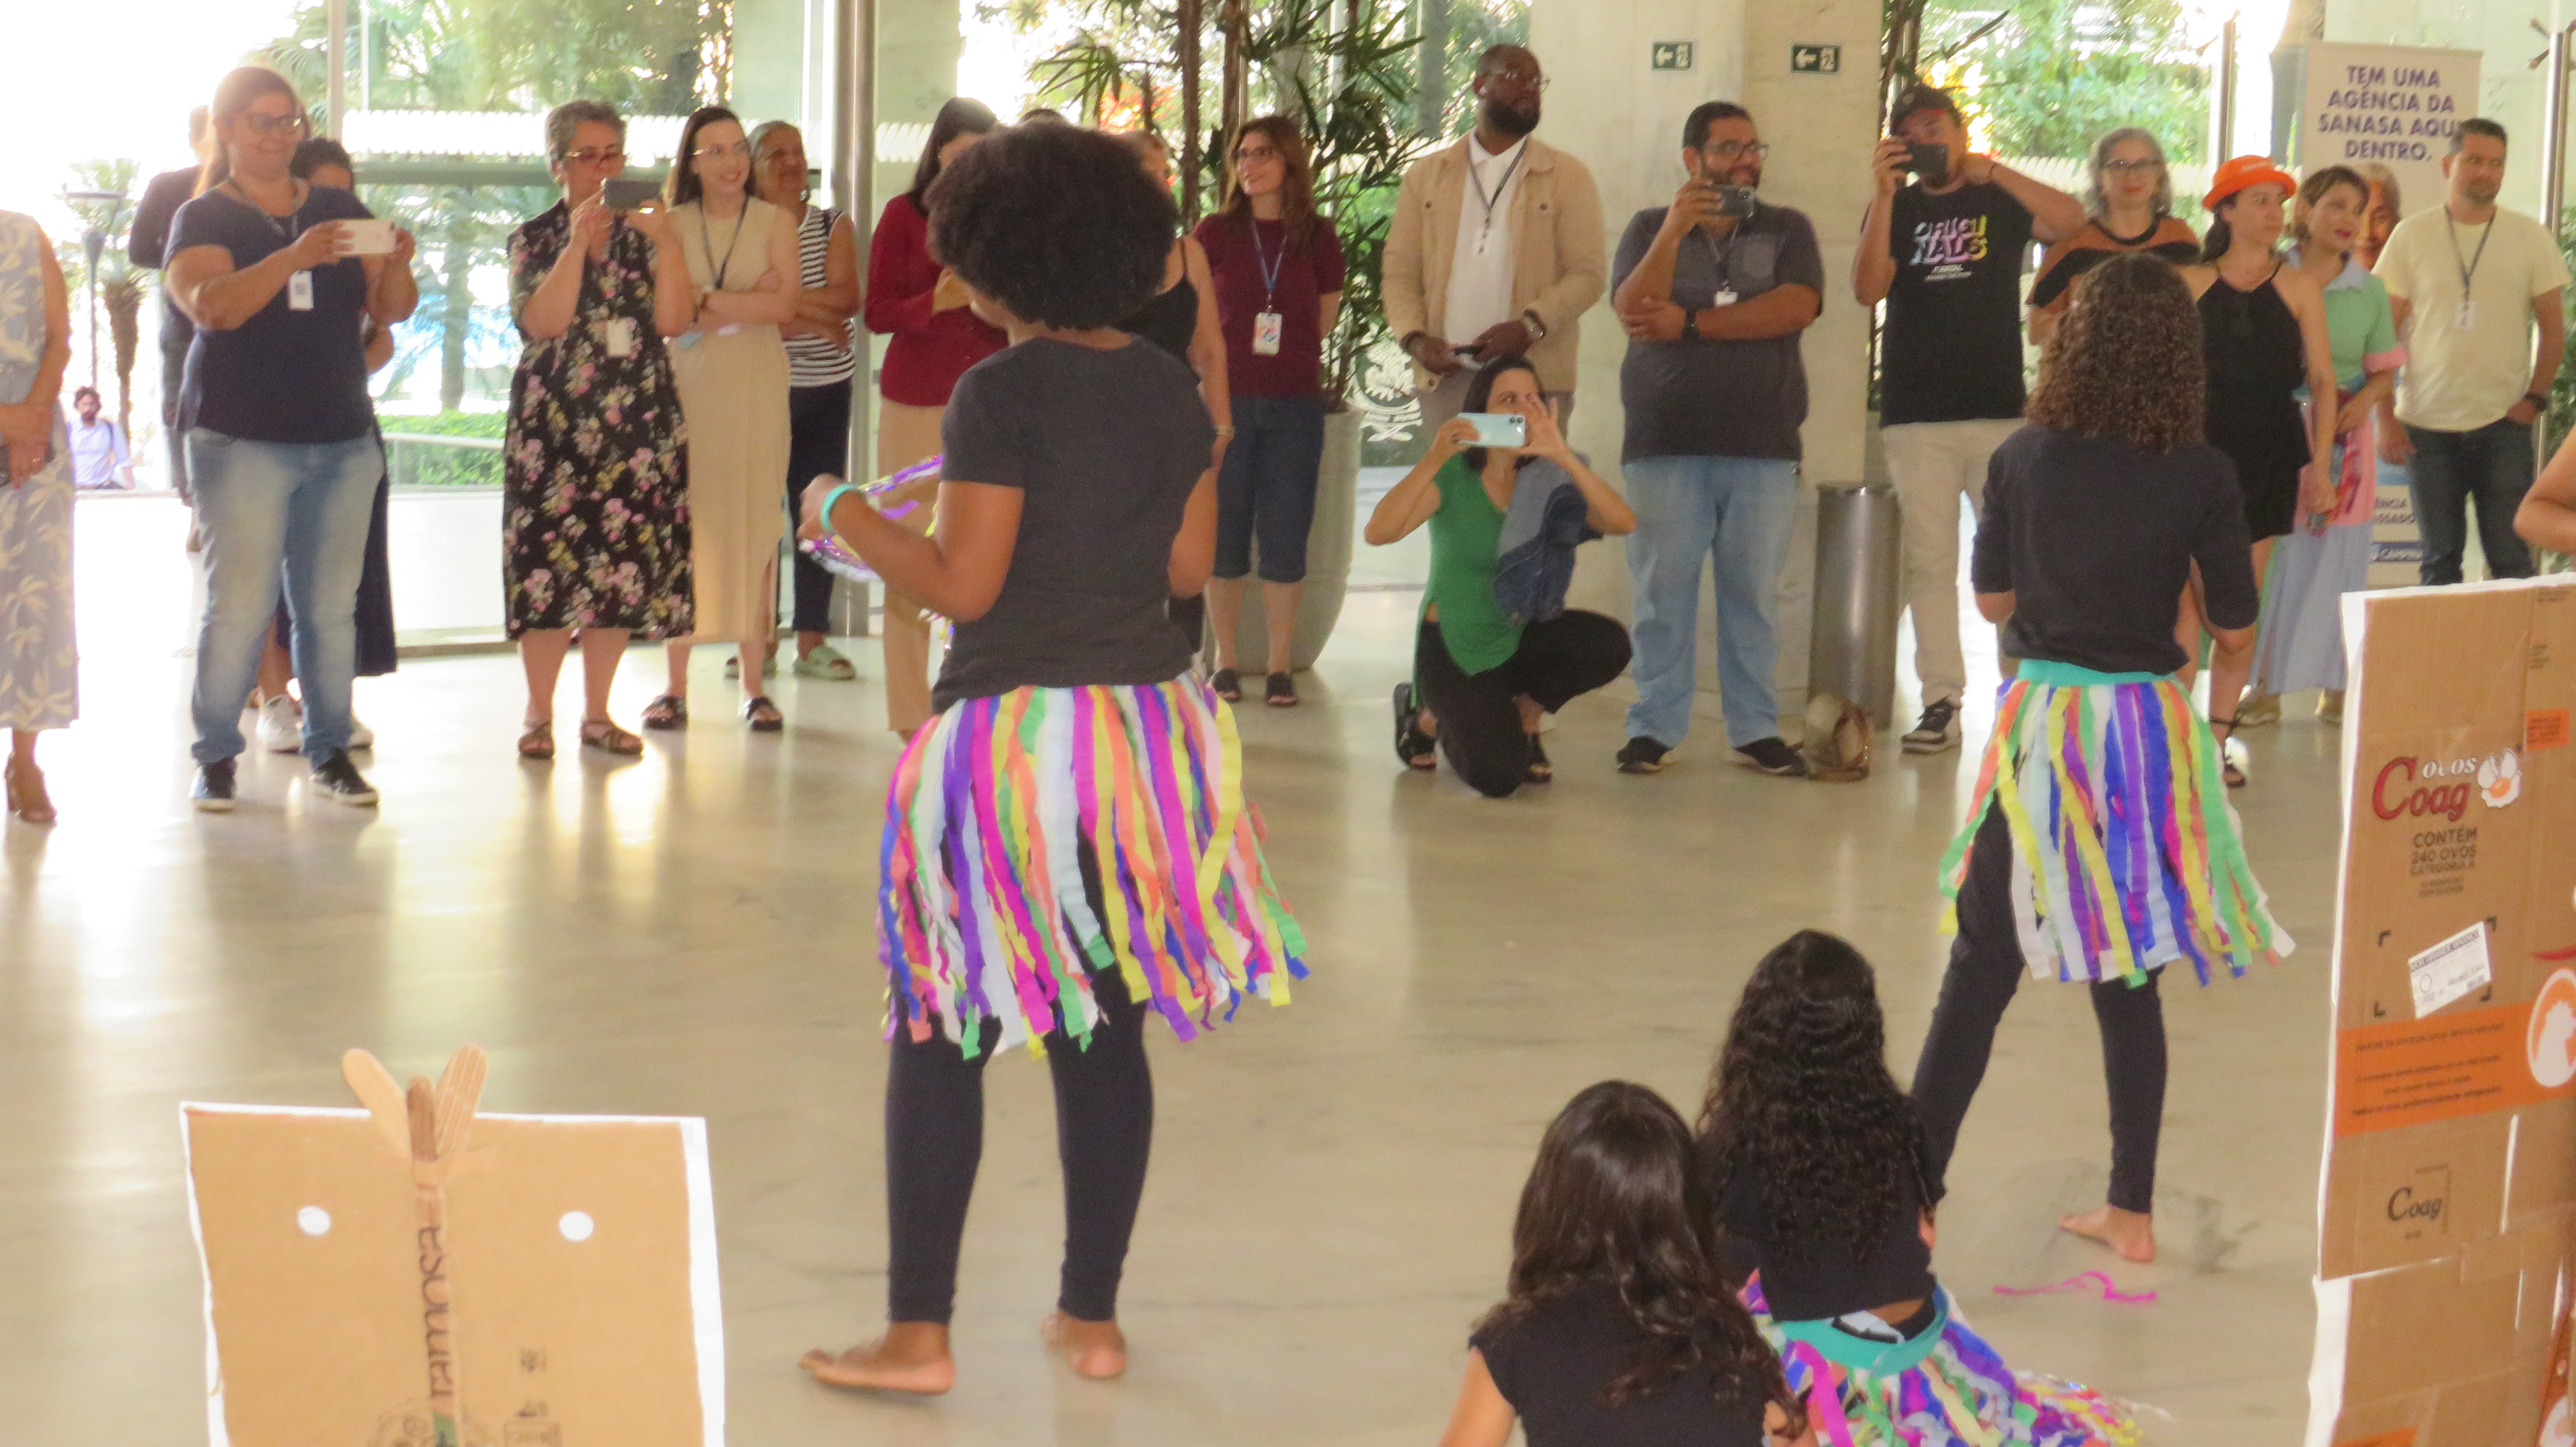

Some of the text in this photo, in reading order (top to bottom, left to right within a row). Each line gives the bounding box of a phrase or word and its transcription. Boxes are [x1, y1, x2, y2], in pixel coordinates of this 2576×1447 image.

[2347, 65, 2440, 88] TEM UMA
[2427, 93, 2454, 113] DA
[2318, 113, 2402, 136] SANASA
[2344, 139, 2432, 161] DENTRO.
[2372, 756, 2471, 822] Coag
[2387, 1186, 2443, 1221] Coag
